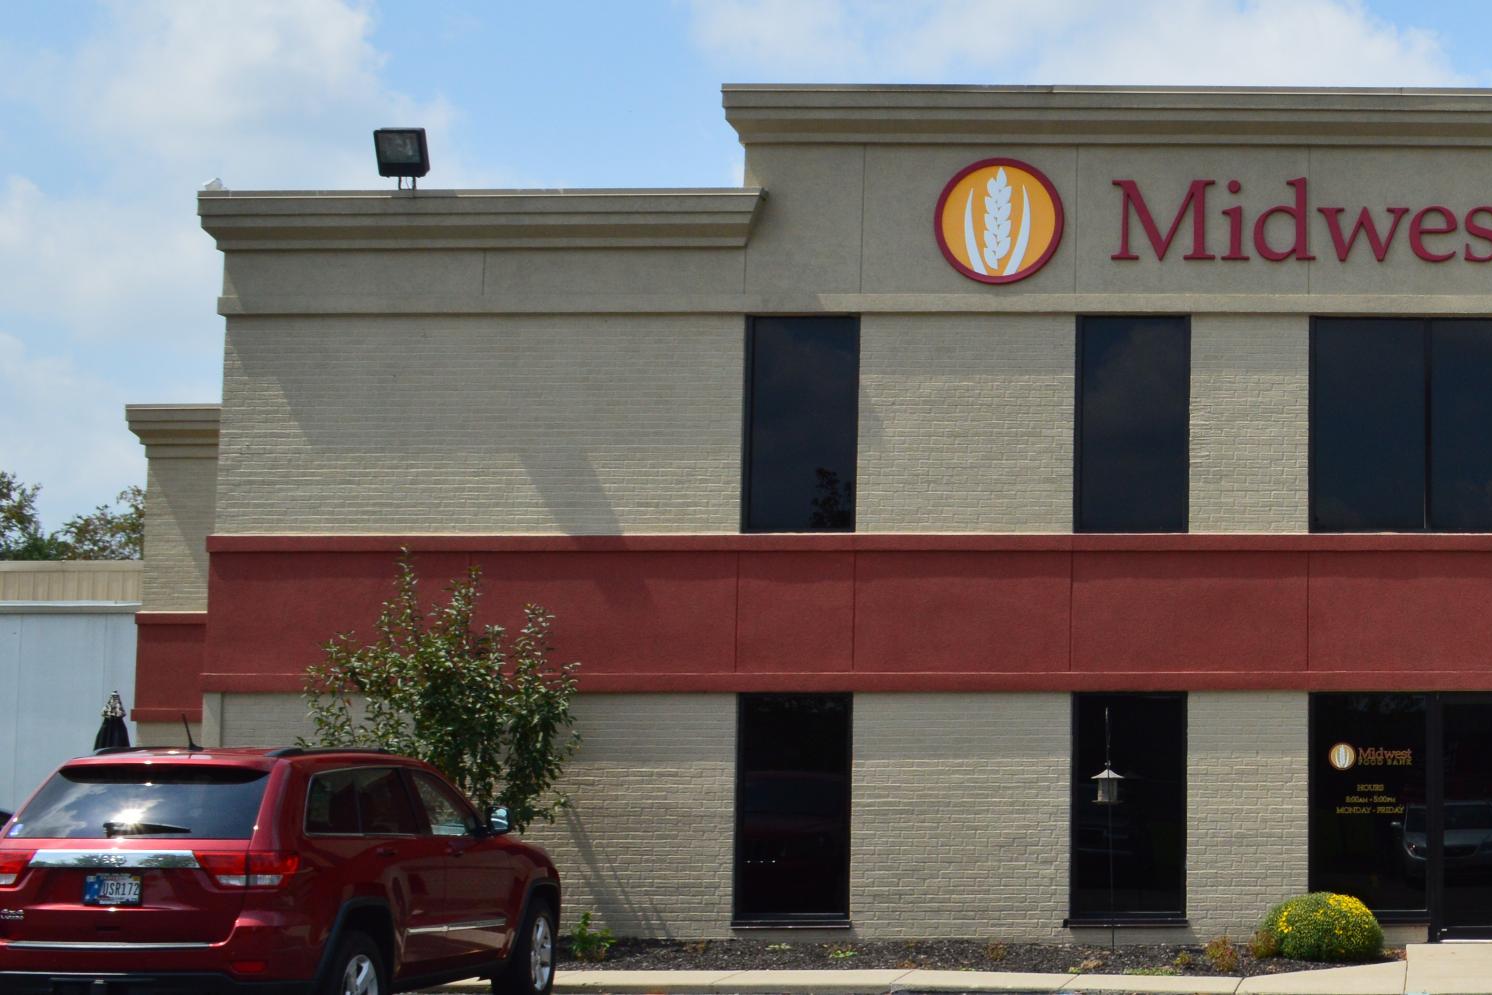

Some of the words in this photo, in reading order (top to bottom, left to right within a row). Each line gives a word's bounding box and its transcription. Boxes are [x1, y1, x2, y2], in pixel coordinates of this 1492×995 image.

[1358, 747, 1412, 760] Midwest
[1356, 784, 1384, 792] HOURS
[1336, 806, 1371, 814] MONDAY
[1376, 805, 1405, 814] FRIDAY
